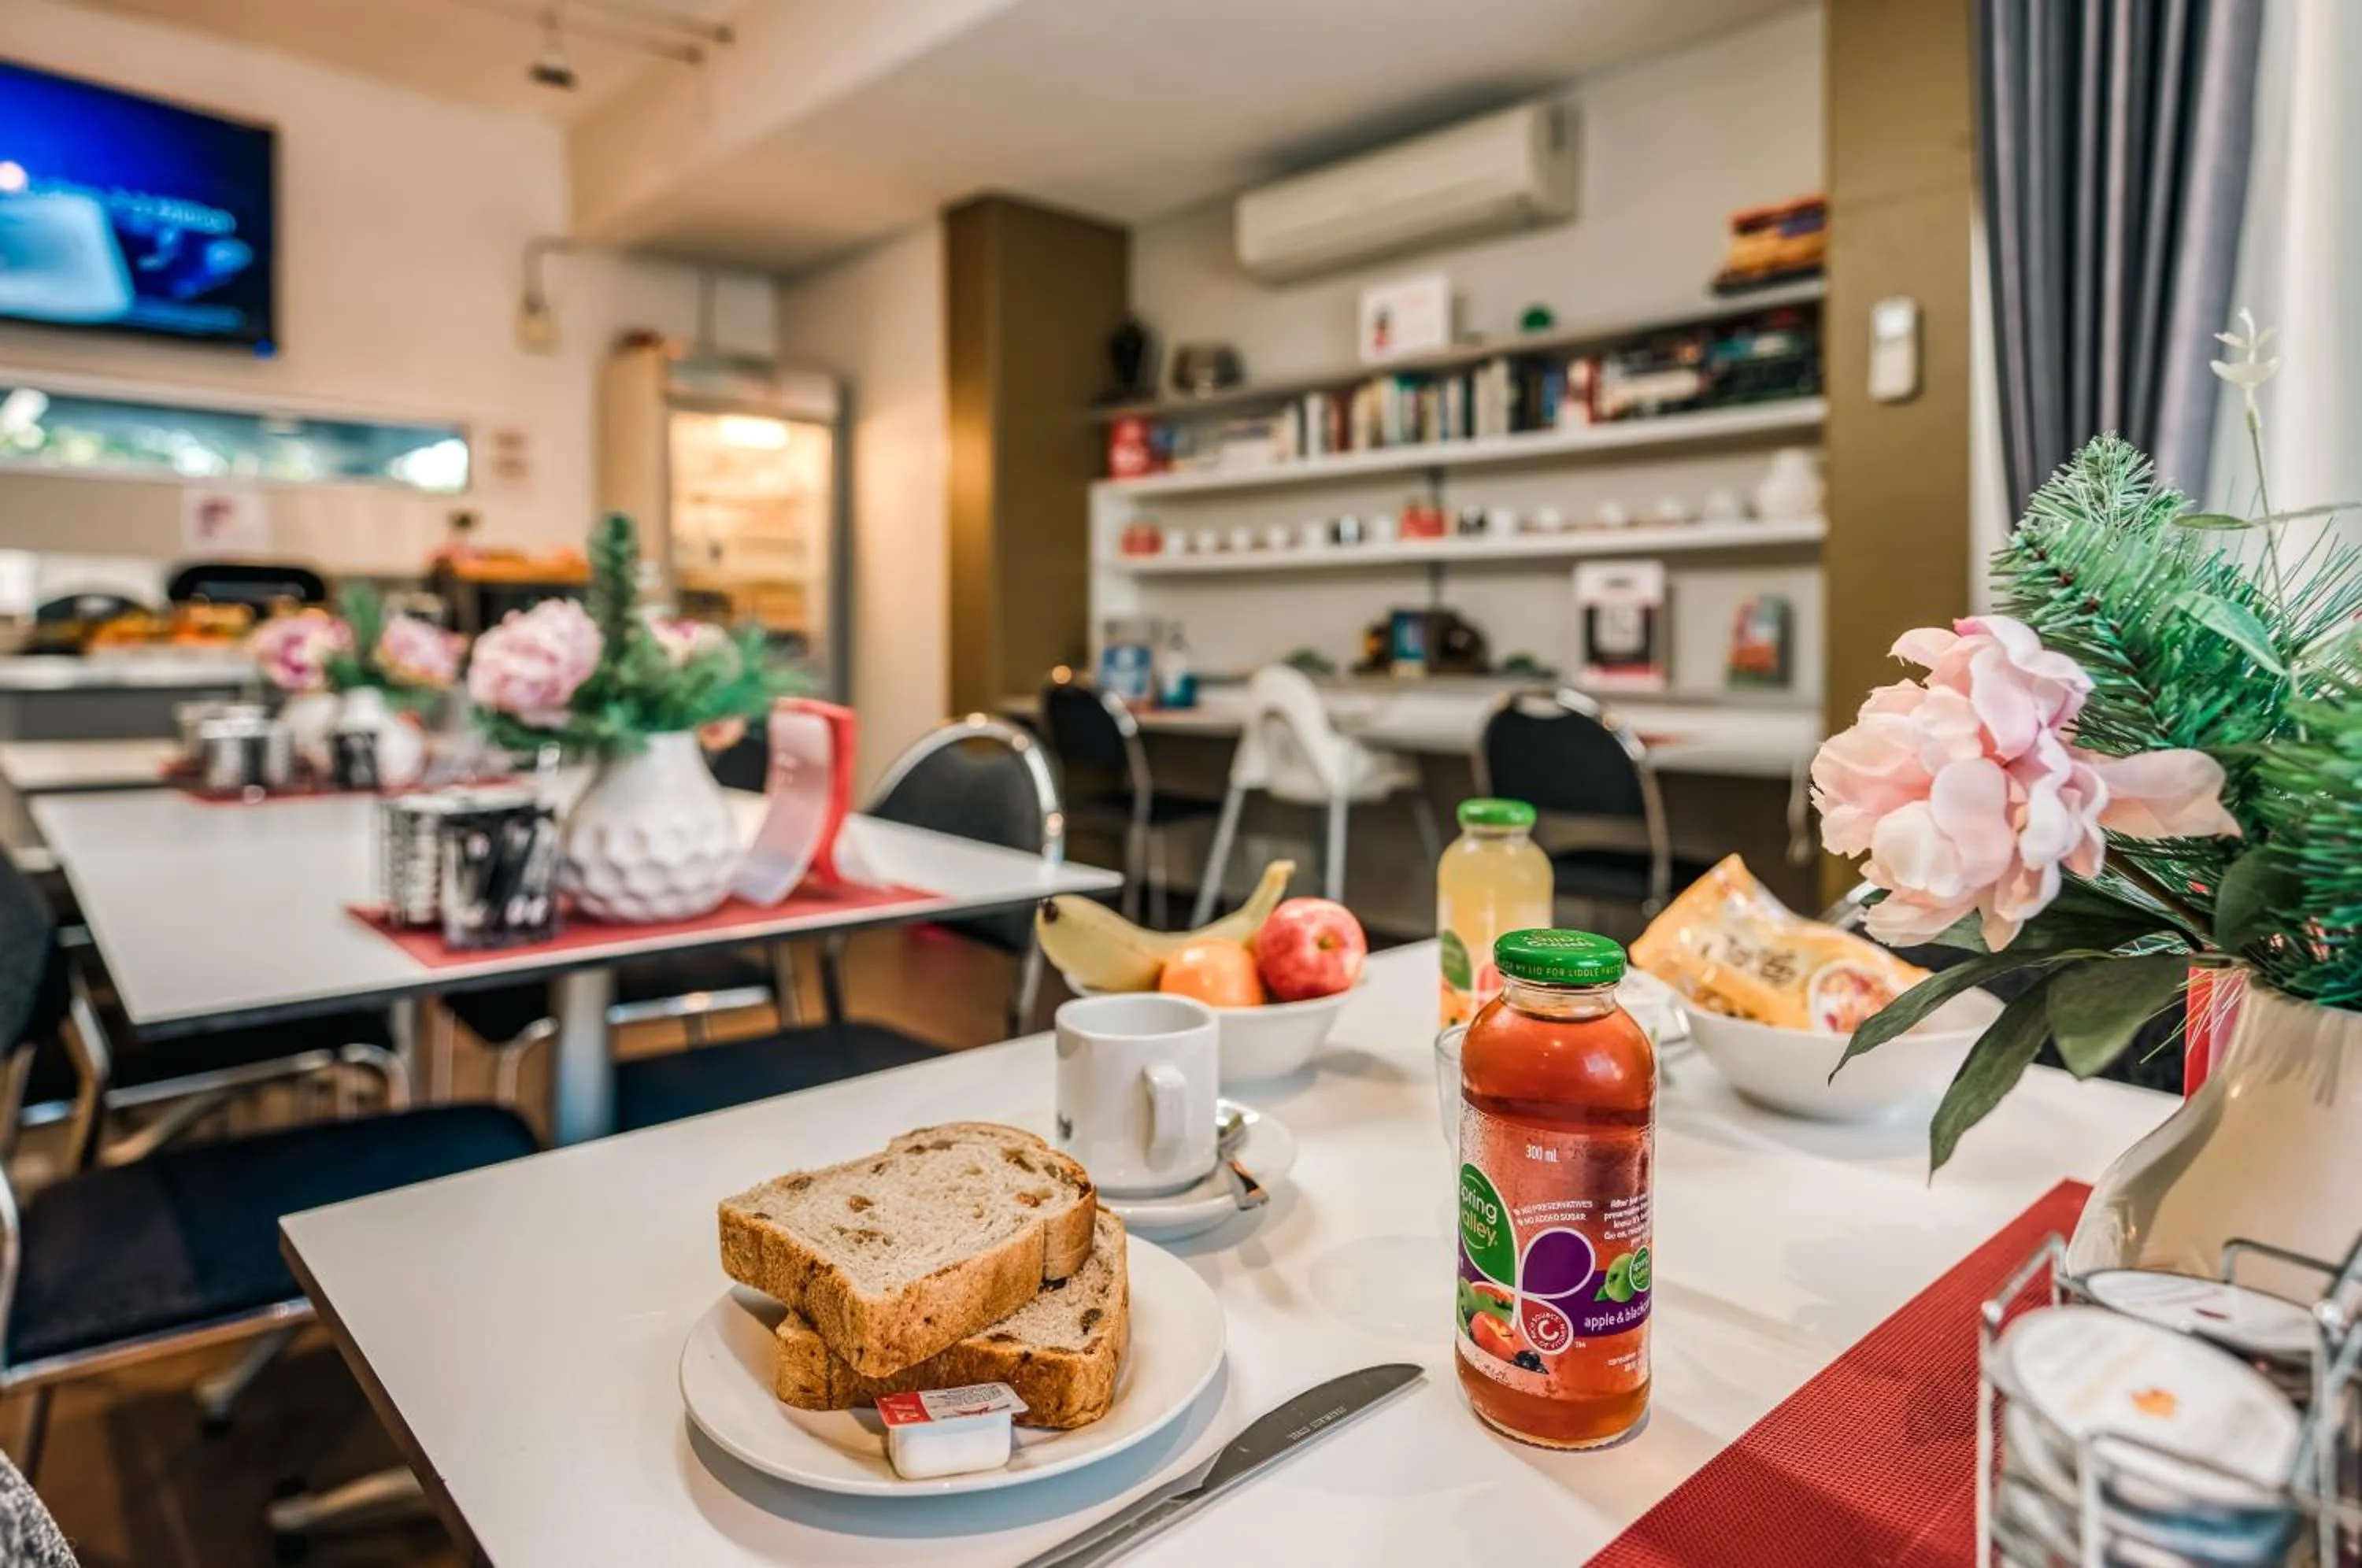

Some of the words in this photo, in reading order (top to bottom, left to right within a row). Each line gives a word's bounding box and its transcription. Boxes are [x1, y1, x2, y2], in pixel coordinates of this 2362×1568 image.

[1524, 1144, 1542, 1159] 300
[1461, 1182, 1498, 1226] pring
[1538, 1319, 1560, 1342] C
[1584, 1311, 1615, 1332] apple
[1616, 1311, 1624, 1323] &
